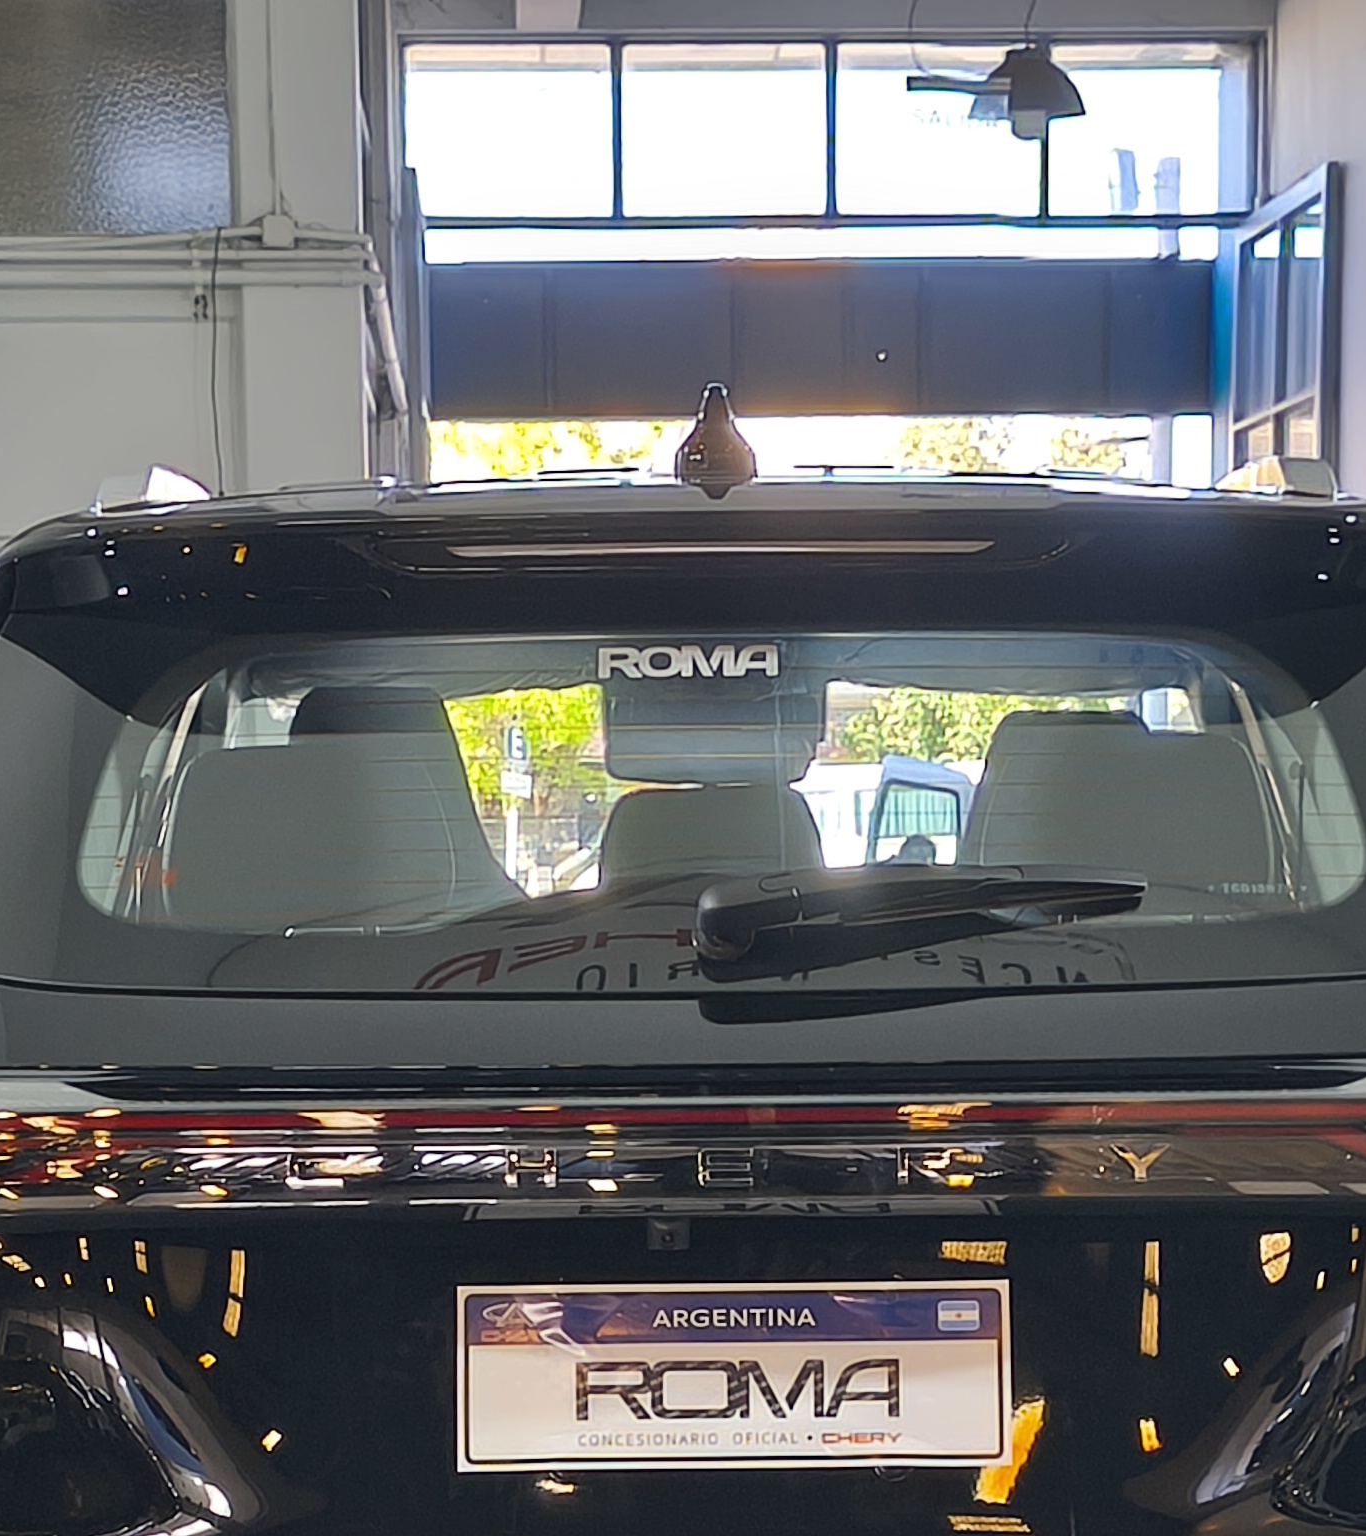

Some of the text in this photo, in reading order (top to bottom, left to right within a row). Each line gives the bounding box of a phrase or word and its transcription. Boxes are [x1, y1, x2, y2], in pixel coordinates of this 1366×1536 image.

[598, 645, 779, 679] ROMA
[652, 1308, 816, 1328] ARGENTINA
[576, 1359, 900, 1421] ROMA
[578, 1432, 902, 1447] CONCESIONARIO OFICIAL CHERY
